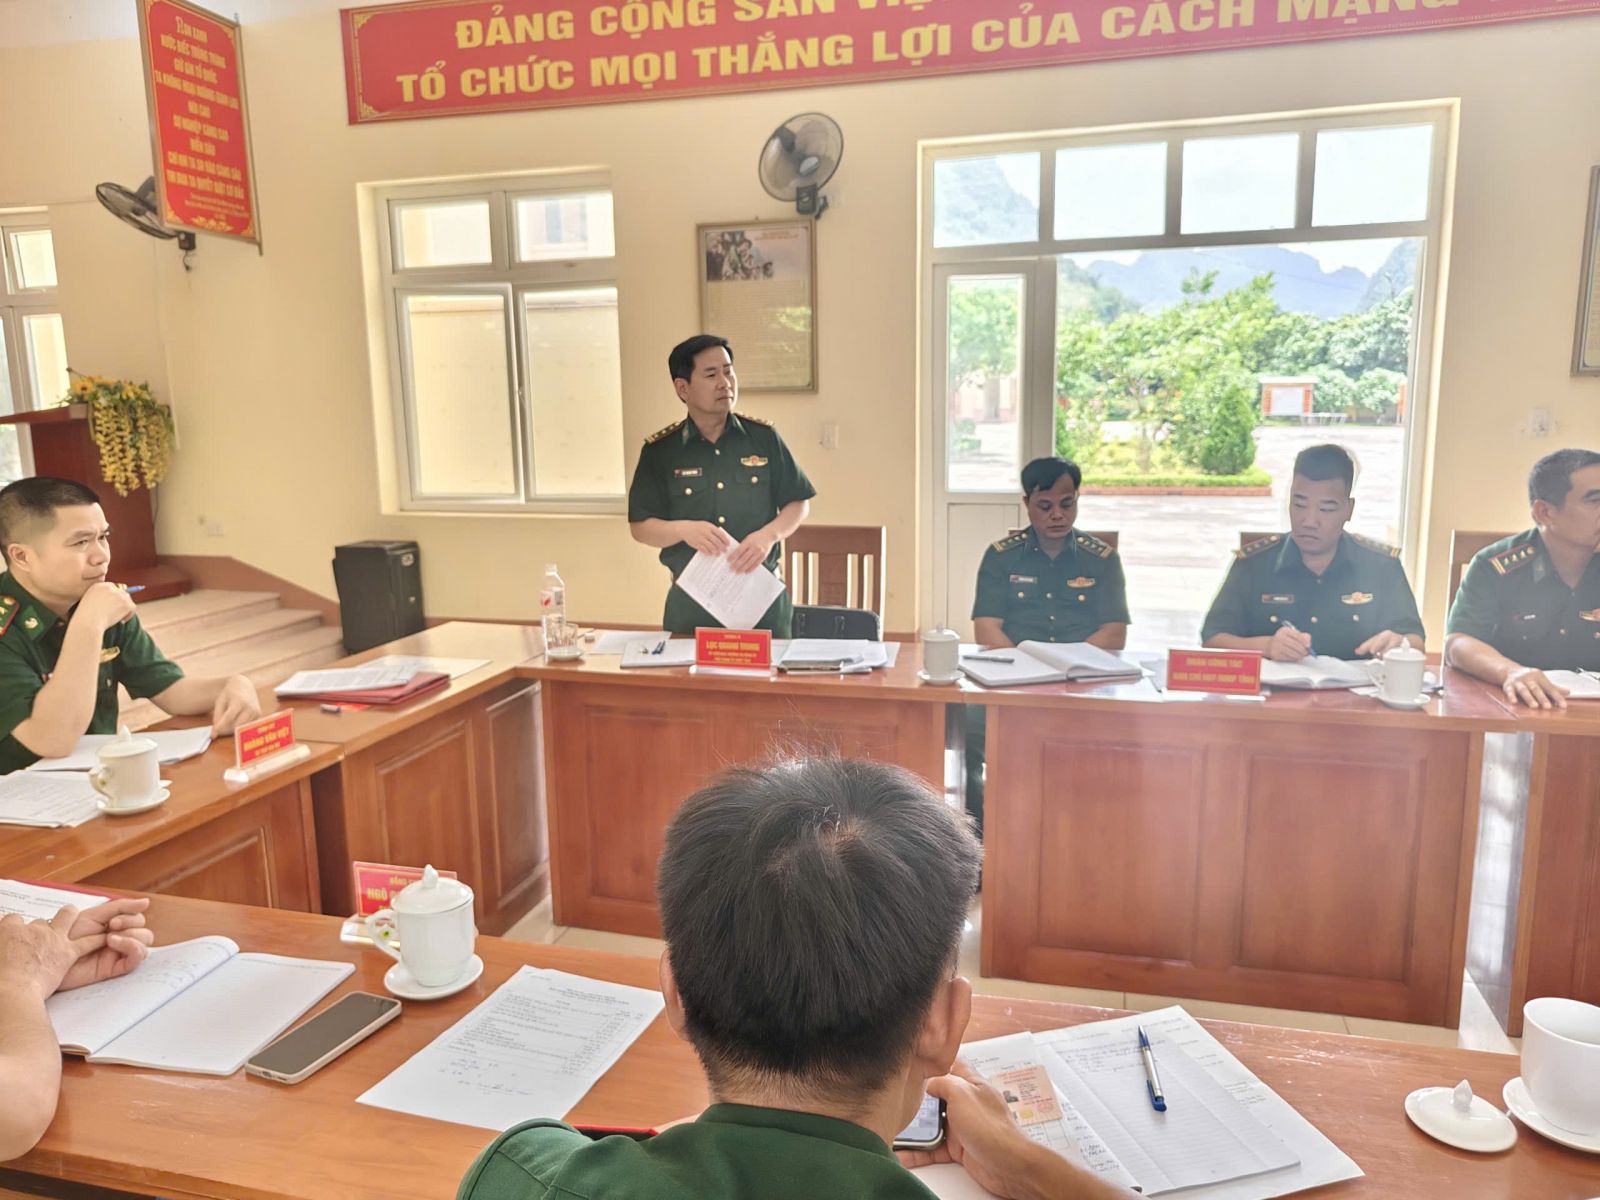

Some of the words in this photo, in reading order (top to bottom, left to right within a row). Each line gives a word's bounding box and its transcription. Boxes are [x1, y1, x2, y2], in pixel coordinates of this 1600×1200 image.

[396, 60, 446, 102] TỔ
[460, 54, 575, 97] CHỨC
[590, 50, 676, 89] MỌI
[690, 31, 854, 78] THẮNG
[872, 23, 951, 65] LỢI
[971, 2, 1081, 53] CỦA
[1100, 0, 1254, 39] CÁCH
[454, 5, 575, 49] ĐẢNG
[590, 0, 716, 39] CỘNG
